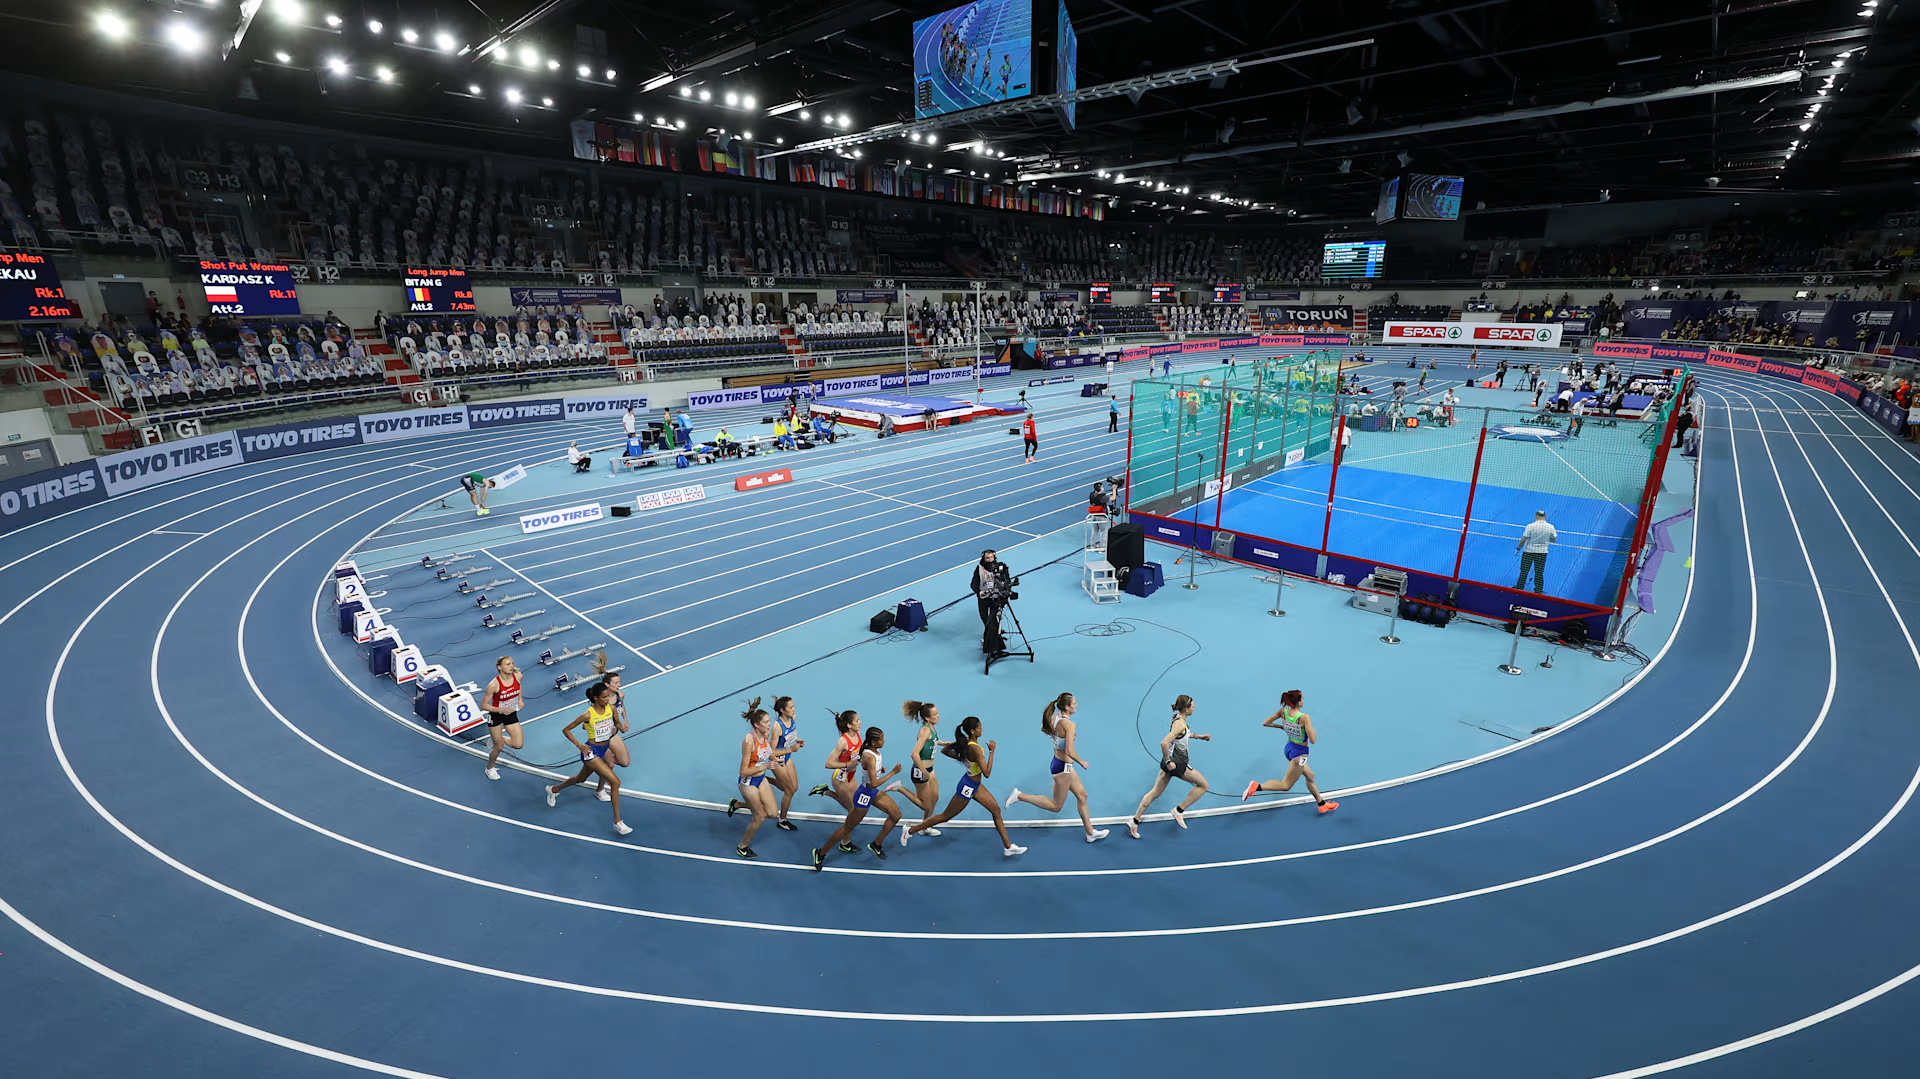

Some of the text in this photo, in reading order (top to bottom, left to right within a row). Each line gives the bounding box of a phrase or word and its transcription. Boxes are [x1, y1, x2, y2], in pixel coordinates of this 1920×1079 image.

[16, 253, 45, 264] Men
[200, 261, 289, 272] Shot Put Women
[408, 267, 428, 277] Long
[317, 266, 340, 280] H2
[578, 273, 595, 284] H2
[201, 274, 275, 285] KARDASZ K
[405, 278, 442, 287] BITAN G
[34, 287, 65, 298] Rk.1
[28, 305, 72, 317] 2.16m
[211, 304, 245, 314] Att.2
[1286, 307, 1348, 321] TORUŃ
[1403, 327, 1446, 337] SPAR
[1488, 329, 1535, 340] SPAR
[881, 375, 905, 386] TOYO
[930, 369, 972, 381] TOYO TIRES
[826, 379, 878, 392] TOYO TIRES
[690, 390, 758, 406] TOYO TIRES
[762, 387, 793, 399] TOYO
[566, 398, 648, 414] TOYO TIRES
[470, 403, 561, 423] TOYO TIRES
[364, 411, 464, 435] TOYO TIRES
[141, 420, 201, 446] F1 G1
[242, 422, 356, 453] TOYO TIRES
[105, 439, 234, 484] TOYO TIRES
[21, 469, 97, 509] TIRES
[522, 507, 600, 529] TOYO TIRES
[345, 584, 357, 594] 2
[364, 619, 377, 632] 4
[404, 657, 418, 672] 6
[456, 704, 471, 721] 8
[859, 794, 869, 804] 10
